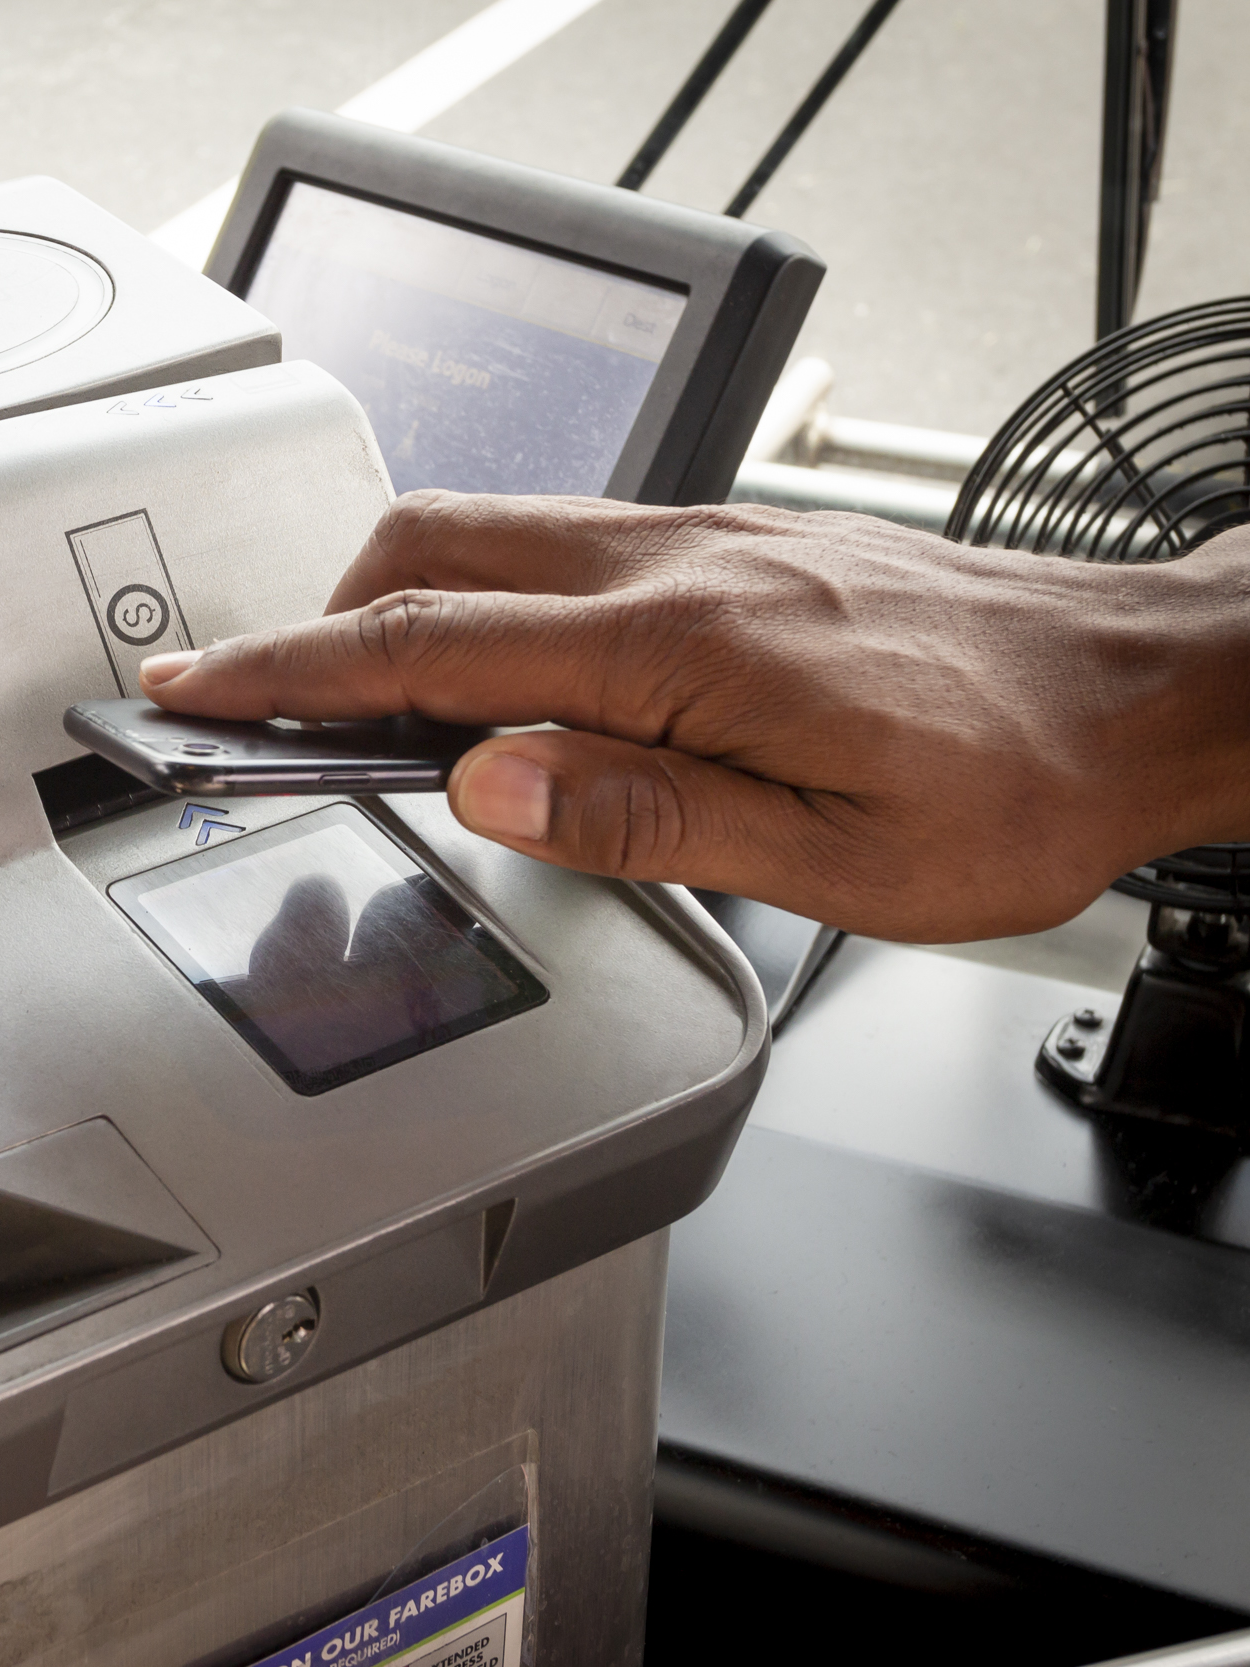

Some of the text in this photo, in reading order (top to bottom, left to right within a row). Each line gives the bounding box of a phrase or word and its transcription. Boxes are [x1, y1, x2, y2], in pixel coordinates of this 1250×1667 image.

[368, 328, 492, 389] Please Logon
[321, 1618, 379, 1661] OUR
[389, 1552, 504, 1629] FAREBOX
